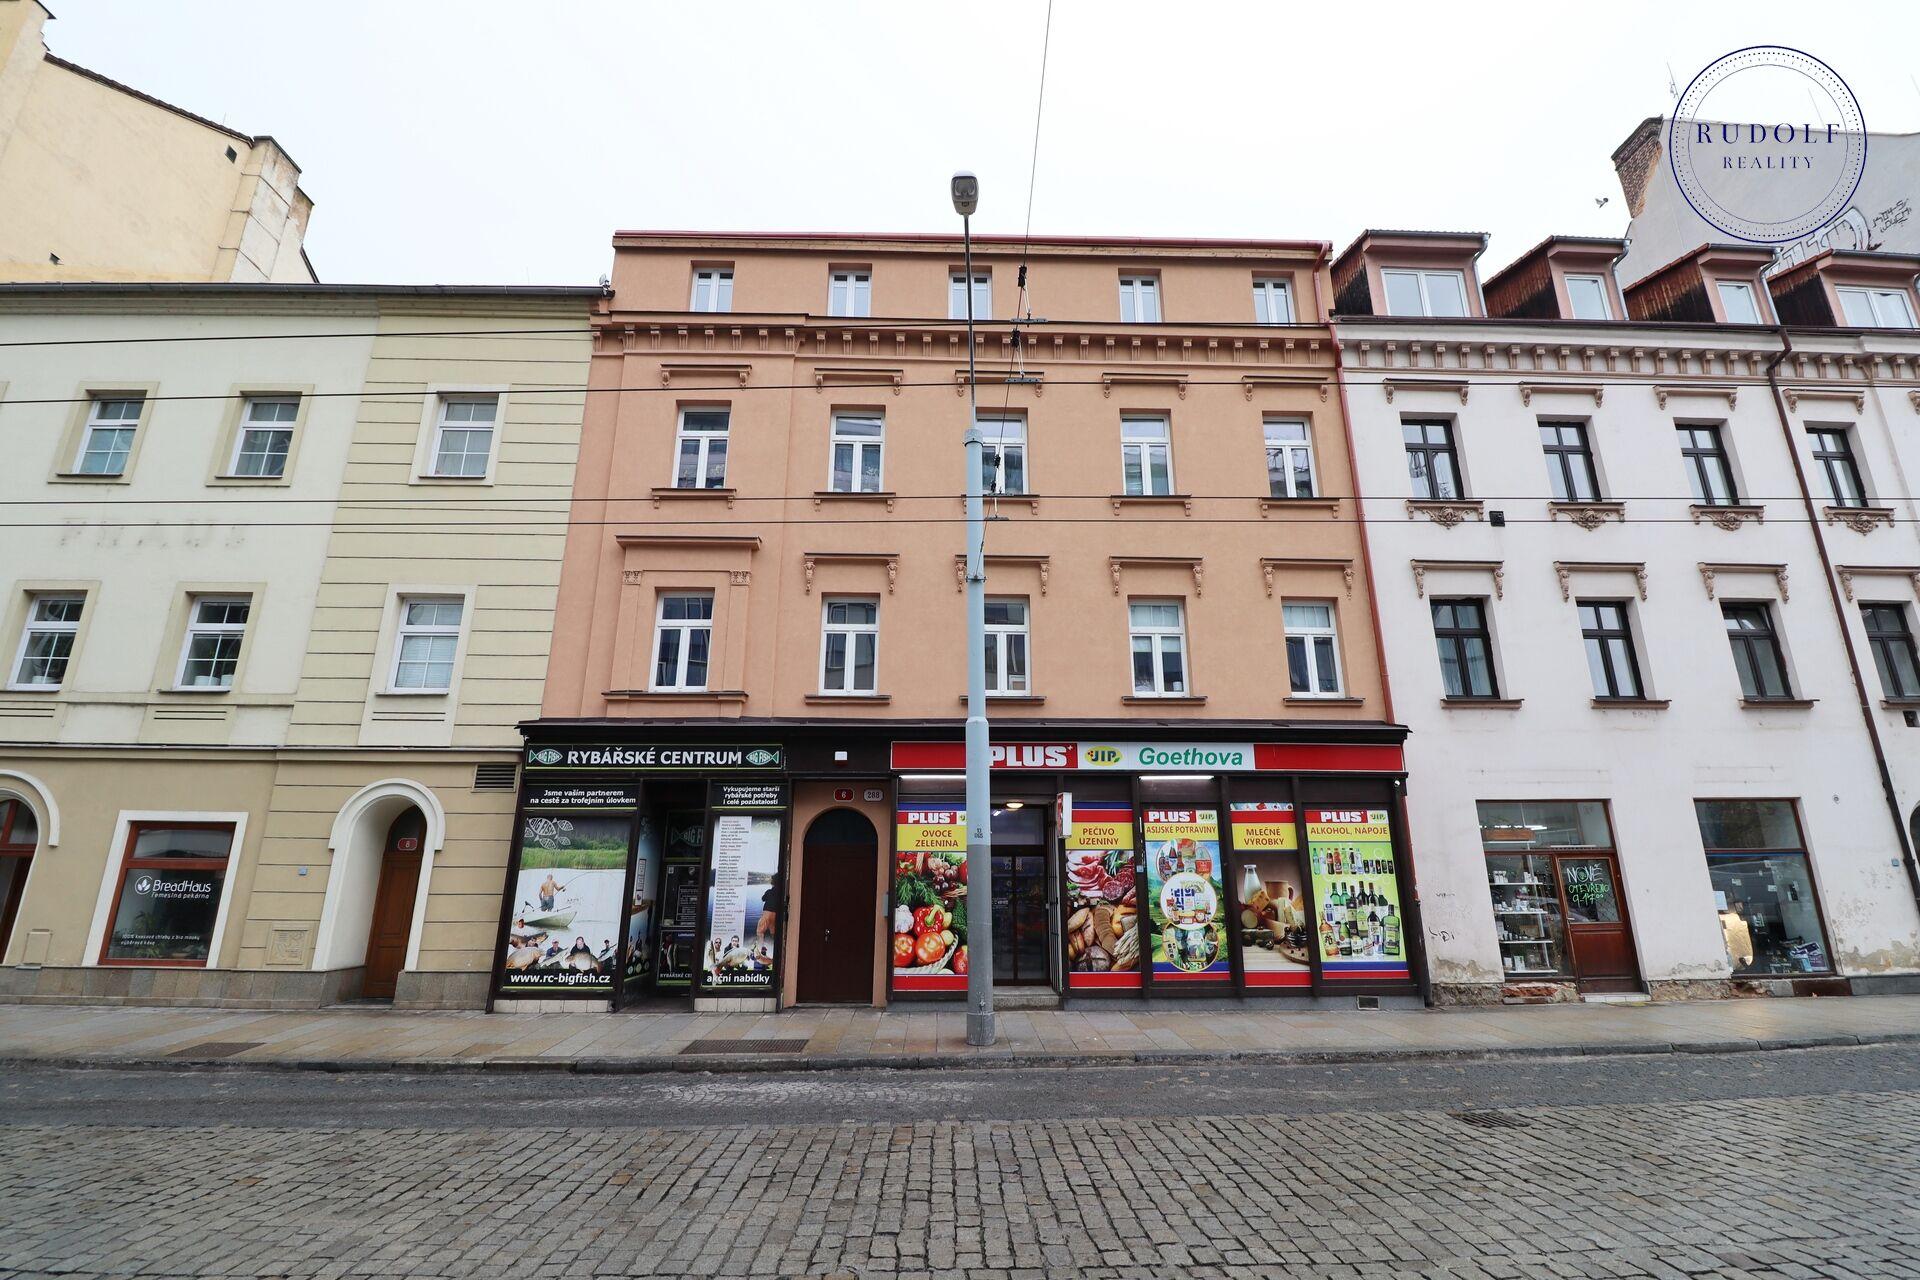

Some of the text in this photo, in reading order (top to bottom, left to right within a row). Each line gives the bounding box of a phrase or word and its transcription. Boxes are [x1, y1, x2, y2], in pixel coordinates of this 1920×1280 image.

[567, 746, 742, 765] RYBÁŘSKÉ CENTRUM
[989, 746, 1068, 767] PLUS
[1090, 750, 1117, 762] JIP
[1139, 747, 1243, 766] Goethova
[544, 789, 562, 797] Jsme
[586, 790, 624, 798] partnerem
[841, 791, 847, 799] 6
[867, 791, 880, 799] 288
[540, 796, 560, 804] cestě
[571, 797, 604, 805] trofejním
[606, 796, 636, 804] úlovkem
[907, 812, 951, 824] PLUS
[1148, 811, 1191, 822] PLUS
[1320, 811, 1362, 822] PLUS
[922, 829, 953, 838] OVOCE
[1175, 826, 1217, 834] POTRAVINY
[1245, 826, 1281, 836] MLEČNÉ
[1310, 827, 1353, 835] ALKOHOL,
[915, 839, 959, 848] ZELENINA
[1079, 838, 1119, 846] UZENINY
[153, 880, 212, 893] BreadHaus
[510, 973, 611, 985] www.rc-bigfish.cz
[733, 973, 770, 985] nabídky
